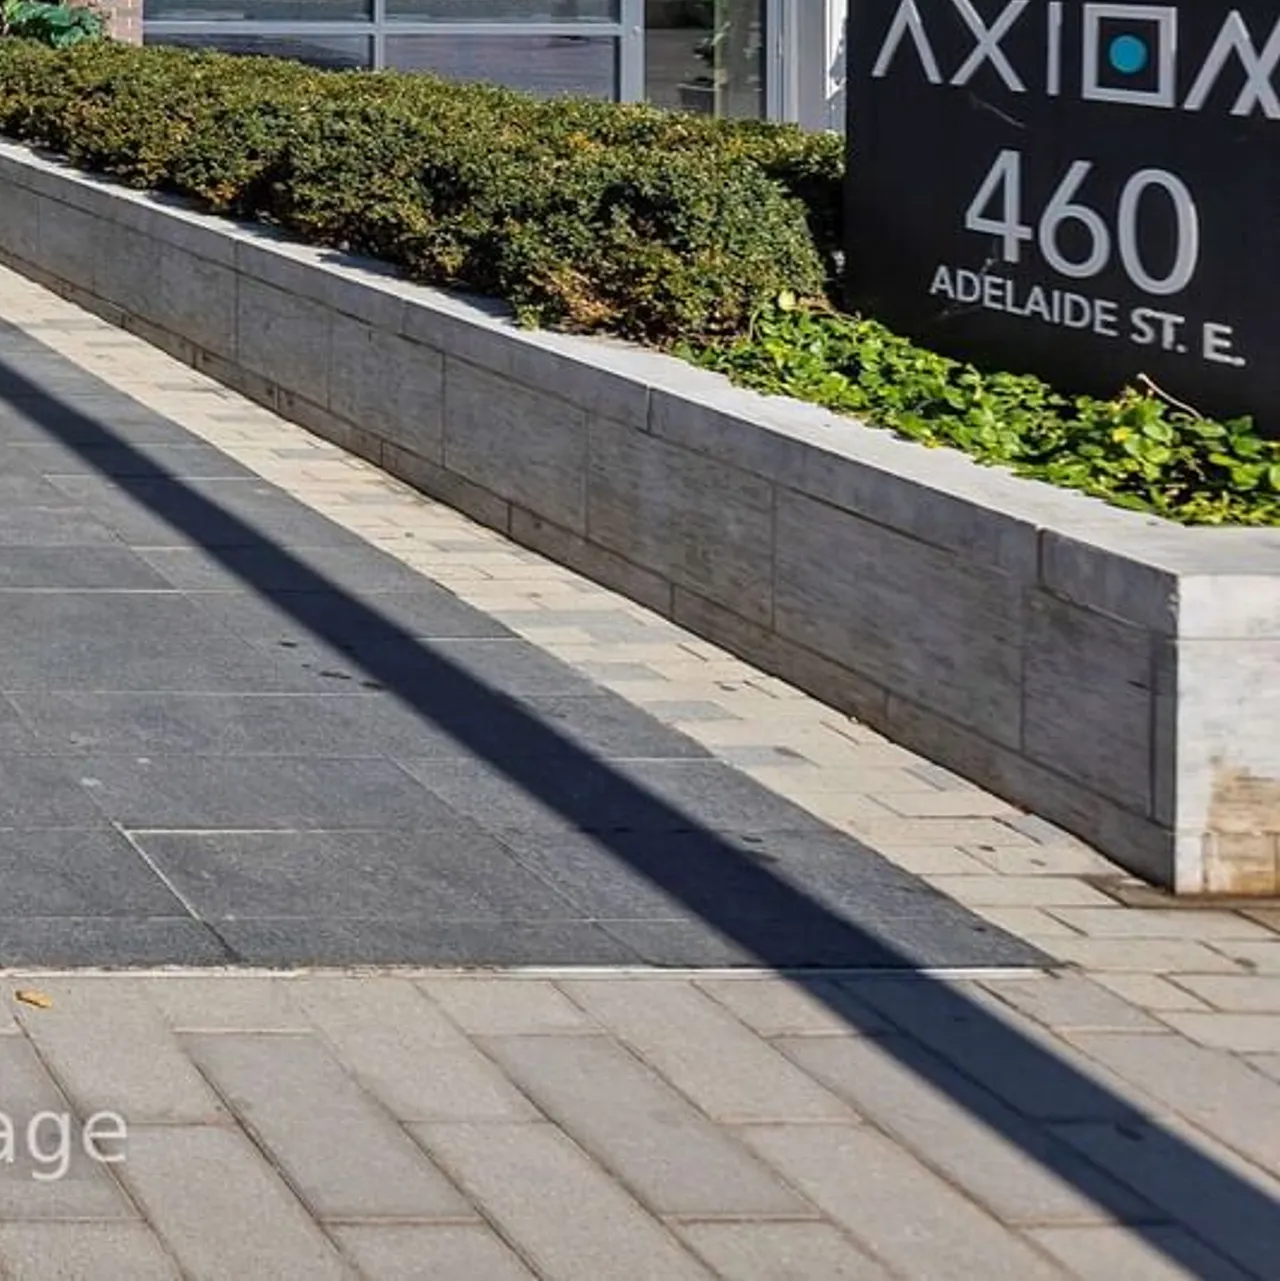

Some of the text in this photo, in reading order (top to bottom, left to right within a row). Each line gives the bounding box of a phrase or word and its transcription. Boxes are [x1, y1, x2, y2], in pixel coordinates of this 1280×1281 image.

[964, 149, 1200, 296] 460
[929, 265, 1119, 338] ADELAIDE
[1130, 308, 1188, 354] ST.
